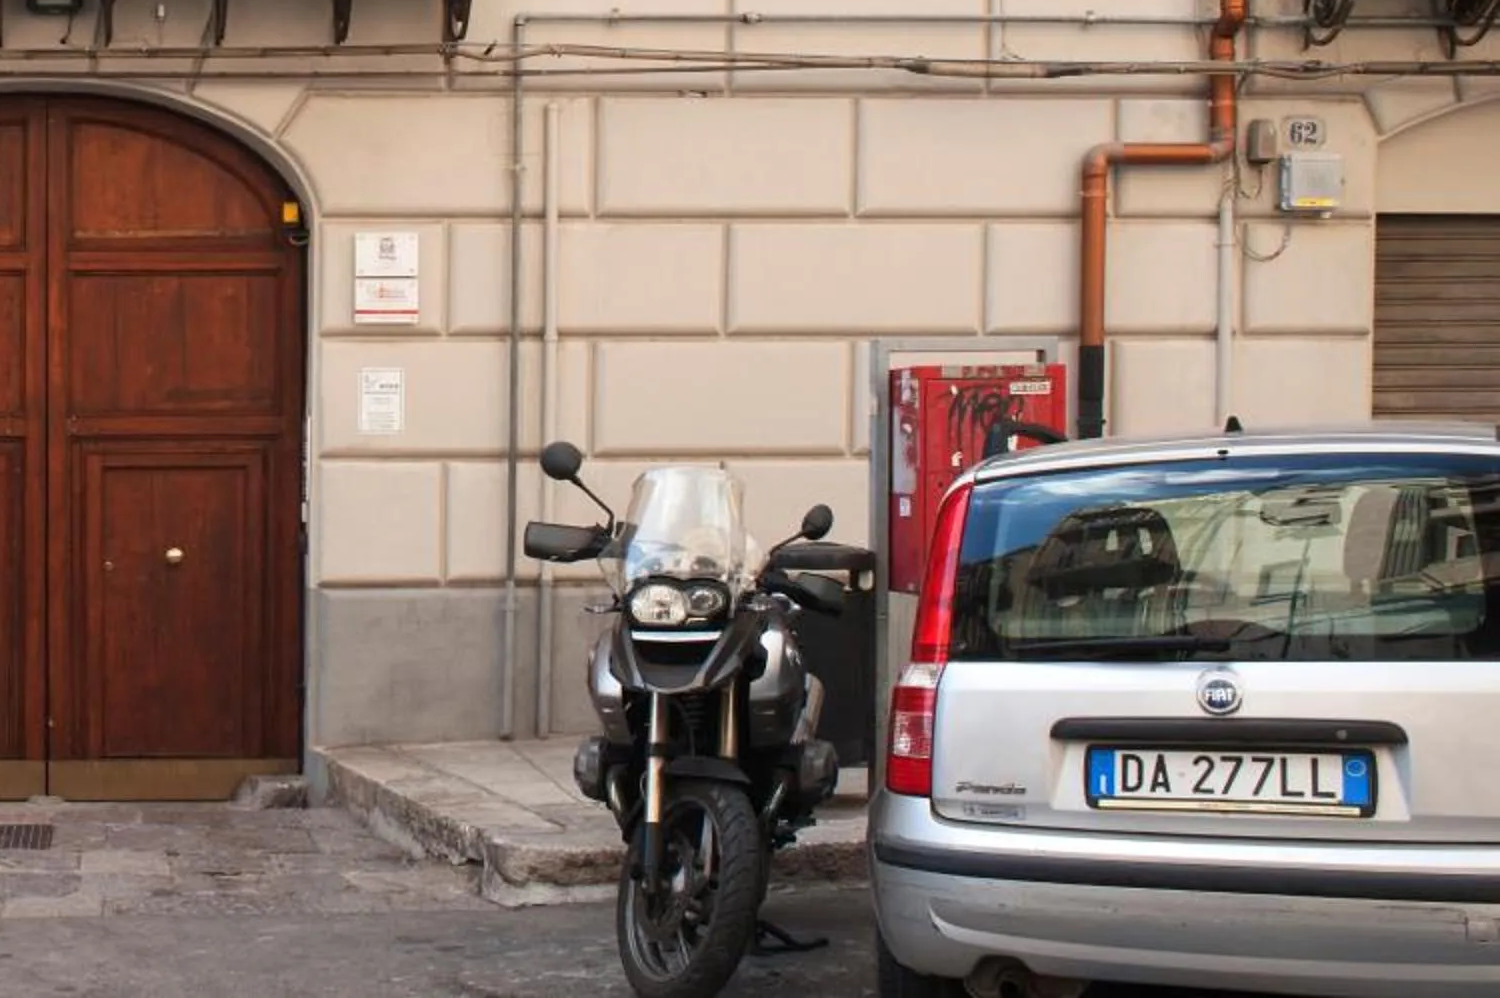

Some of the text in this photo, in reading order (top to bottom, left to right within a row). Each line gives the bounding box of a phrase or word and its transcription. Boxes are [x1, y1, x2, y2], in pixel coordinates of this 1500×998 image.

[1291, 121, 1317, 144] 62
[1205, 688, 1233, 702] FIAT
[1120, 753, 1336, 798] DA 277LL
